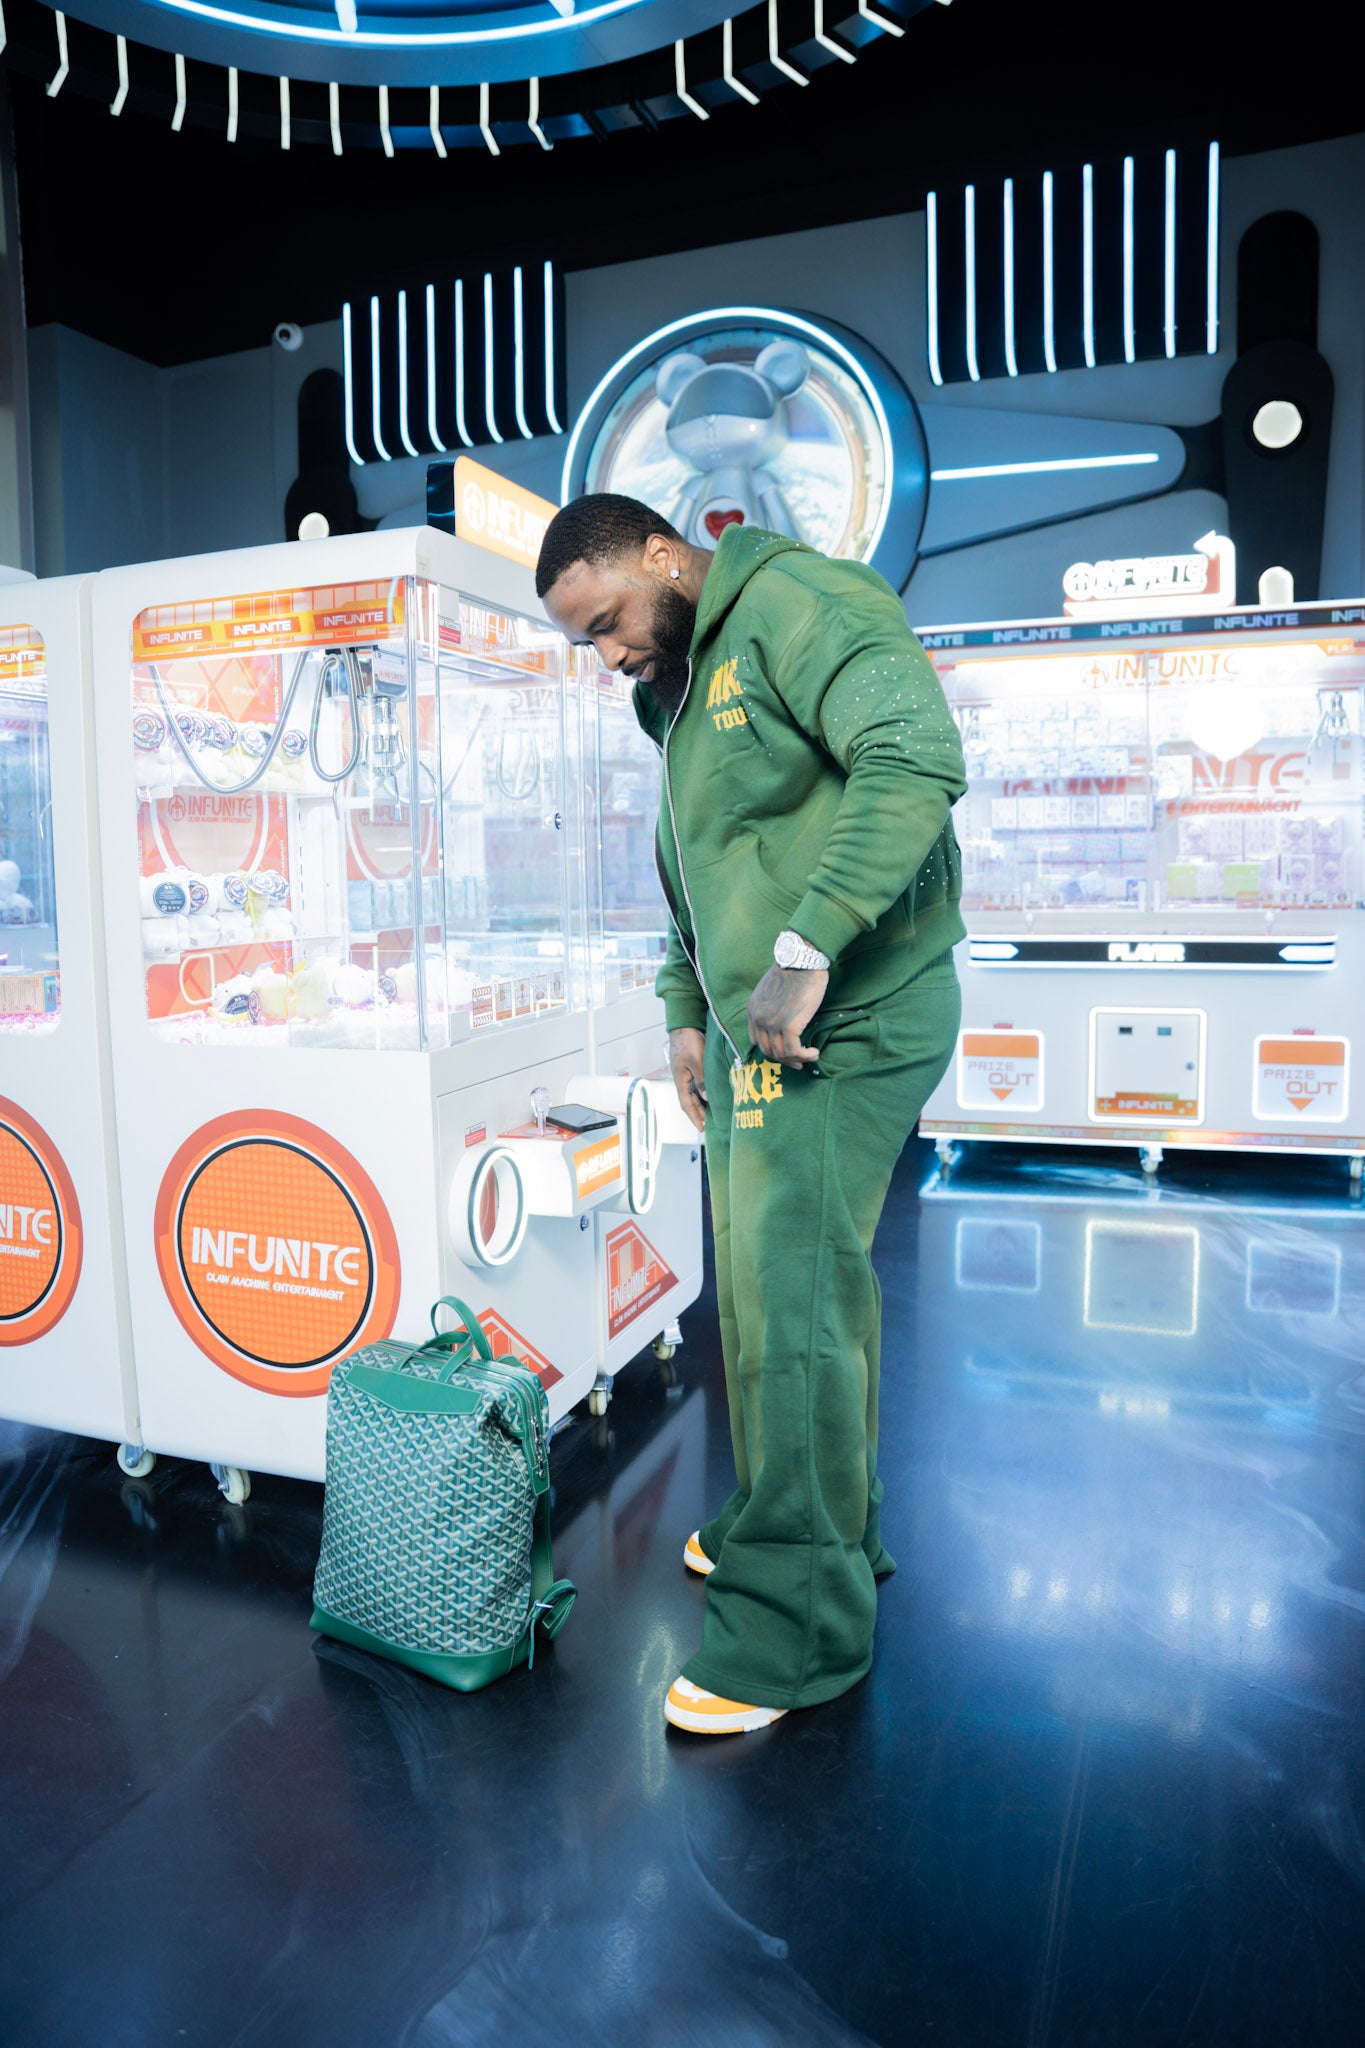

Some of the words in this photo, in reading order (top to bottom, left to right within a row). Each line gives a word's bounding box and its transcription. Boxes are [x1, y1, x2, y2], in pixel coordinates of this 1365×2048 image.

[324, 611, 384, 627] INFUNITE
[1214, 612, 1299, 630] INFUNITE
[234, 620, 292, 636] INFUNITE
[992, 626, 1072, 643] INFUNITE
[1101, 619, 1184, 637] INFUNITE
[150, 630, 203, 645] INFUNITE
[188, 795, 253, 817] INFUNITE
[967, 1061, 1015, 1072] PRIZE
[1263, 1068, 1316, 1080] PRIZE
[988, 1072, 1035, 1087] OUT
[1286, 1080, 1337, 1095] OUT
[735, 1108, 764, 1129] TOUR
[191, 1226, 361, 1286] INFUNITE
[206, 1271, 230, 1285] CLAW
[231, 1277, 271, 1291] MACHINE
[272, 1282, 345, 1301] ENTERTAINMENT
